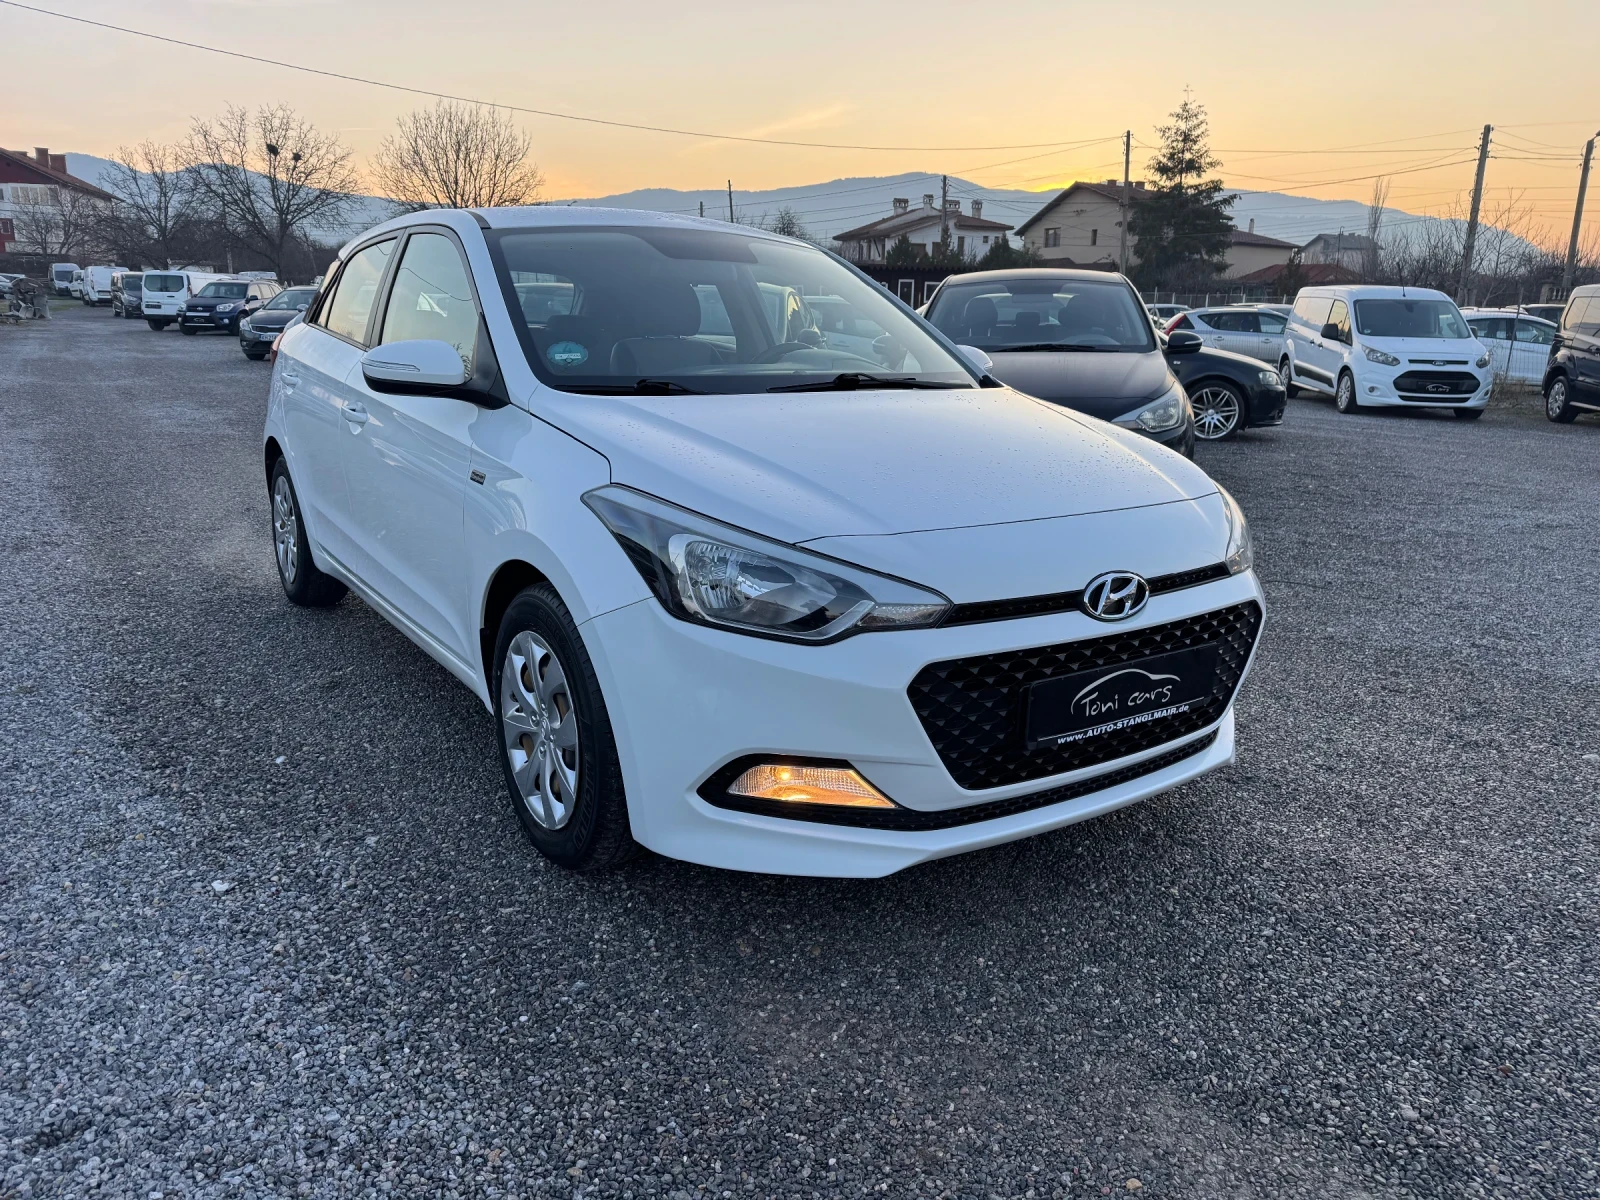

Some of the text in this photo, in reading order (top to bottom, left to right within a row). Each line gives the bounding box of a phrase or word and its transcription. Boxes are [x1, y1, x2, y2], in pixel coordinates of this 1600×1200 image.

[1080, 685, 1173, 717] Toni cars
[1057, 704, 1190, 744] www.AUTO-STANGLMAIR.de
